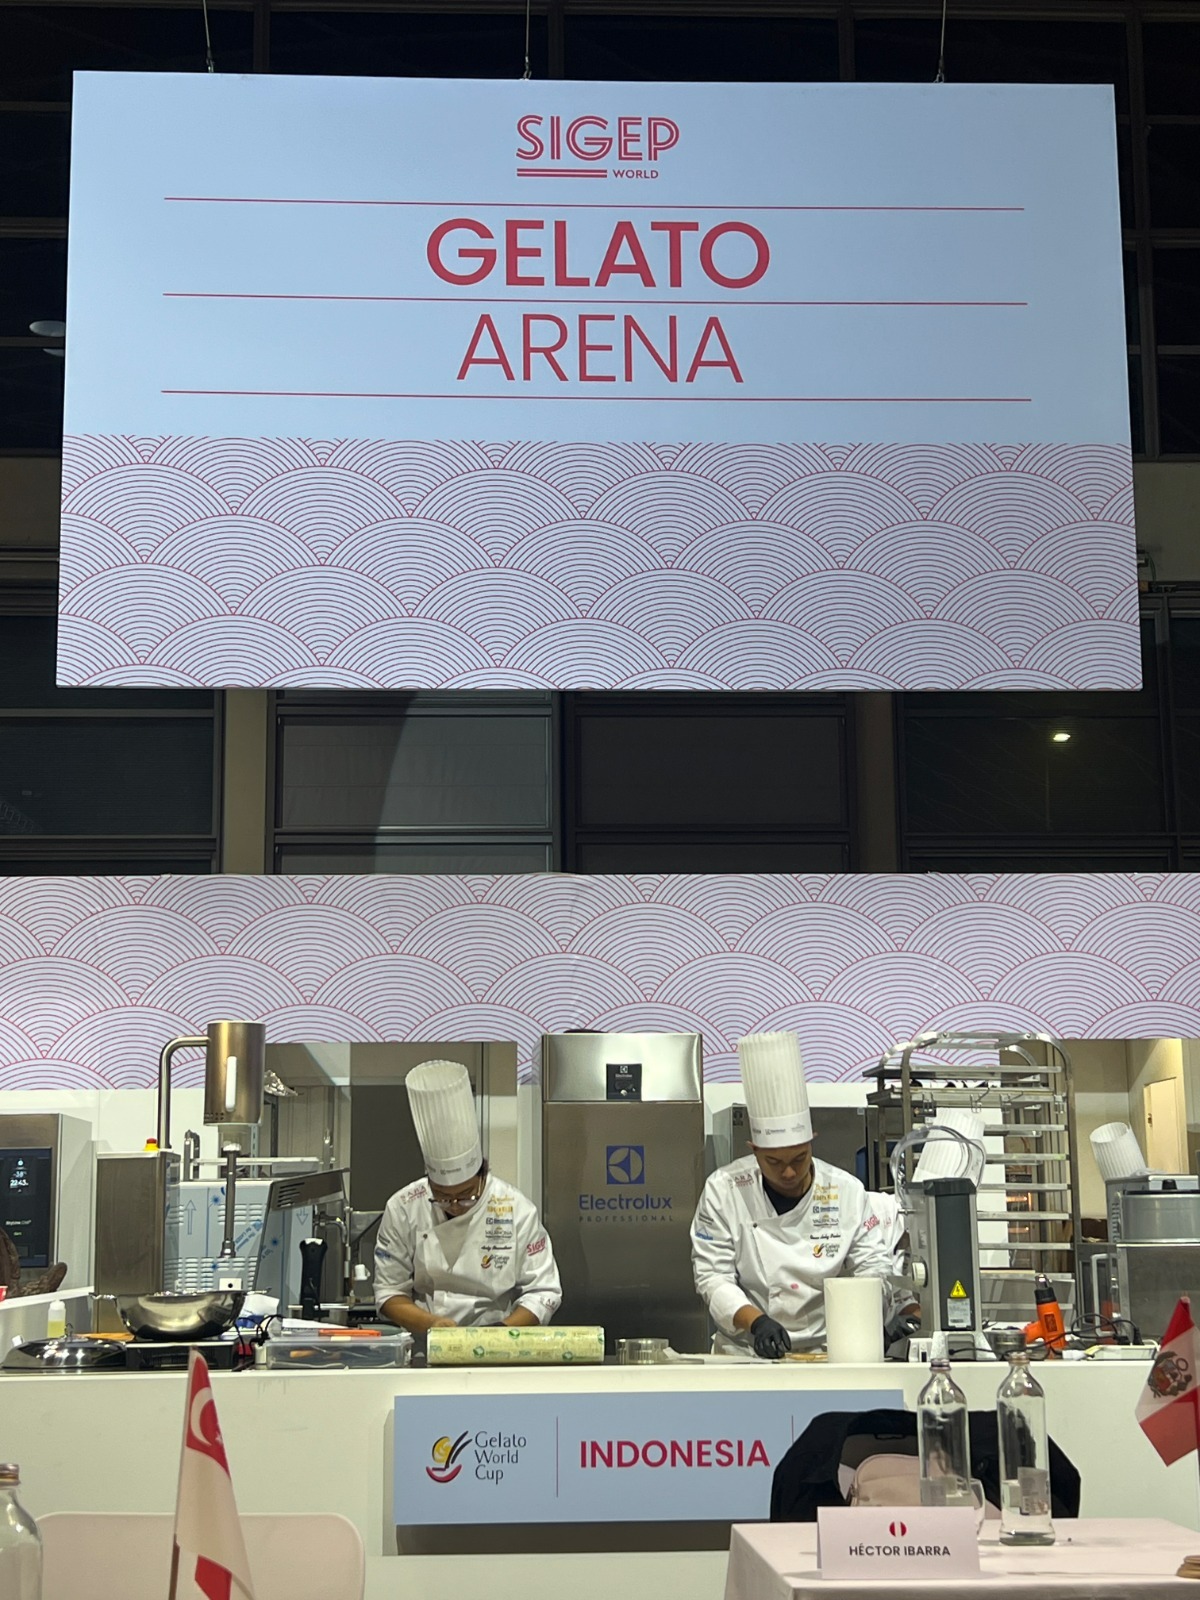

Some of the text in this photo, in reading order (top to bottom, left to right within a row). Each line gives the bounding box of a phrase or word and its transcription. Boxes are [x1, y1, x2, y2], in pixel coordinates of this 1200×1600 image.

[516, 114, 680, 162] SIGEP
[612, 169, 659, 179] WORLD
[425, 217, 771, 289] GELATO
[456, 313, 744, 384] ARENA
[579, 1193, 672, 1210] Electrolux
[579, 1214, 673, 1223] PROFESSIONAL
[475, 1431, 527, 1448] Gelato
[474, 1449, 519, 1464] World
[580, 1439, 770, 1469] INDONESIA
[475, 1464, 504, 1485] Cup
[849, 1543, 951, 1556] HÉCTOR IBARRA
